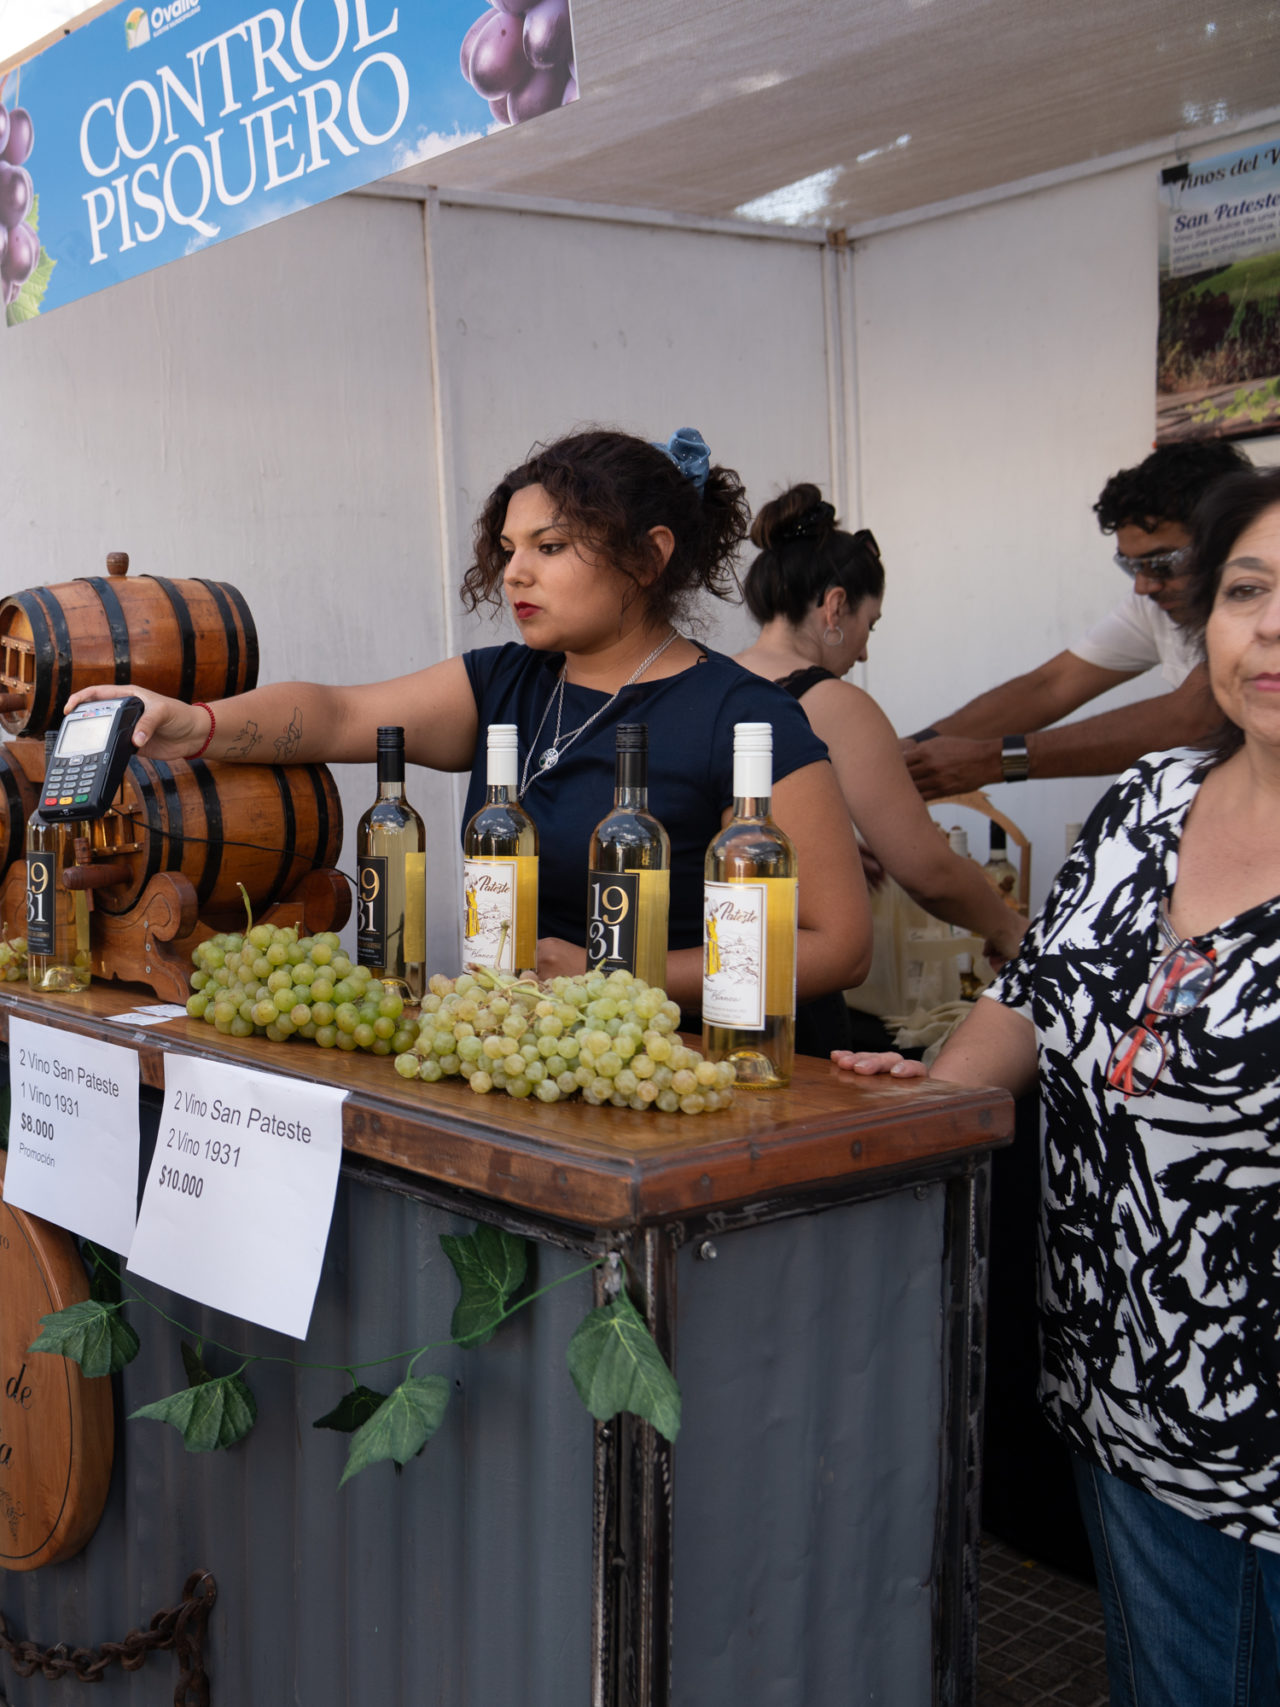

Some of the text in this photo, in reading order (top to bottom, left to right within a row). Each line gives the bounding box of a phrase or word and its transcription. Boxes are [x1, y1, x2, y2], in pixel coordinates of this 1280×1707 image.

[79, 0, 399, 179] CONTROL
[81, 52, 410, 265] PISQUERO
[1229, 153, 1259, 177] del
[1174, 213, 1209, 233] San
[591, 882, 629, 925] 19
[589, 922, 623, 960] 31
[19, 1049, 119, 1098] 2 Vino San Pateste
[21, 1082, 79, 1118] 1 Vino 1931
[174, 1090, 312, 1144] 2 Vino San Pateste
[21, 1112, 54, 1141] $8.000
[19, 1142, 56, 1168] Promoción
[166, 1128, 241, 1168] 2 Vino 1931
[158, 1164, 204, 1199] $10.000
[6, 1363, 33, 1410] de
